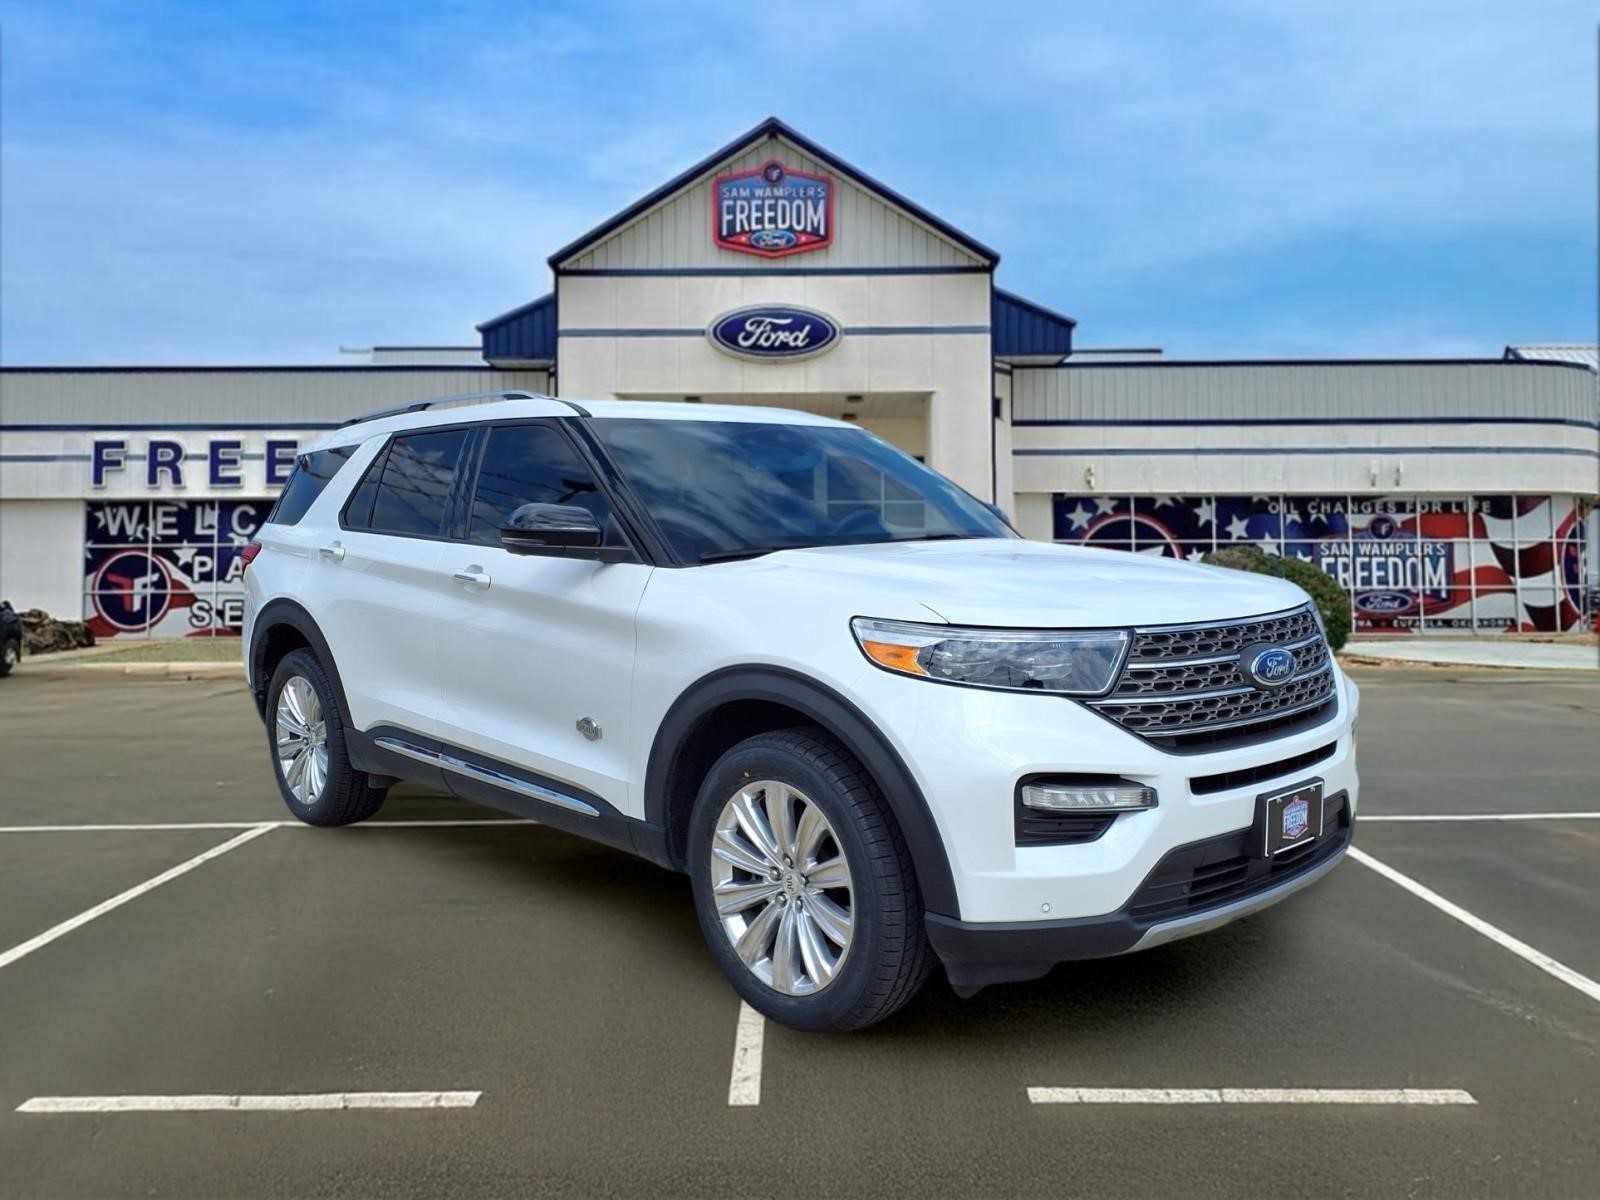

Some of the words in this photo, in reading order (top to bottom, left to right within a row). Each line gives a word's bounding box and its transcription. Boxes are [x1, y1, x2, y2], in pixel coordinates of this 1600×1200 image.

[722, 187, 750, 199] SAM
[721, 199, 825, 236] FREEDOM
[760, 231, 788, 247] Ford
[737, 316, 811, 348] Ford
[92, 440, 299, 488] FREE
[105, 505, 257, 536] WELC
[1267, 501, 1299, 515] OIL
[1307, 501, 1397, 515] CHANGES
[1405, 501, 1443, 515] FOR
[1450, 501, 1492, 515] LIFE
[192, 555, 243, 583] PA
[190, 600, 243, 628] SE
[1365, 595, 1400, 609] Ford
[1265, 655, 1290, 678] Ford
